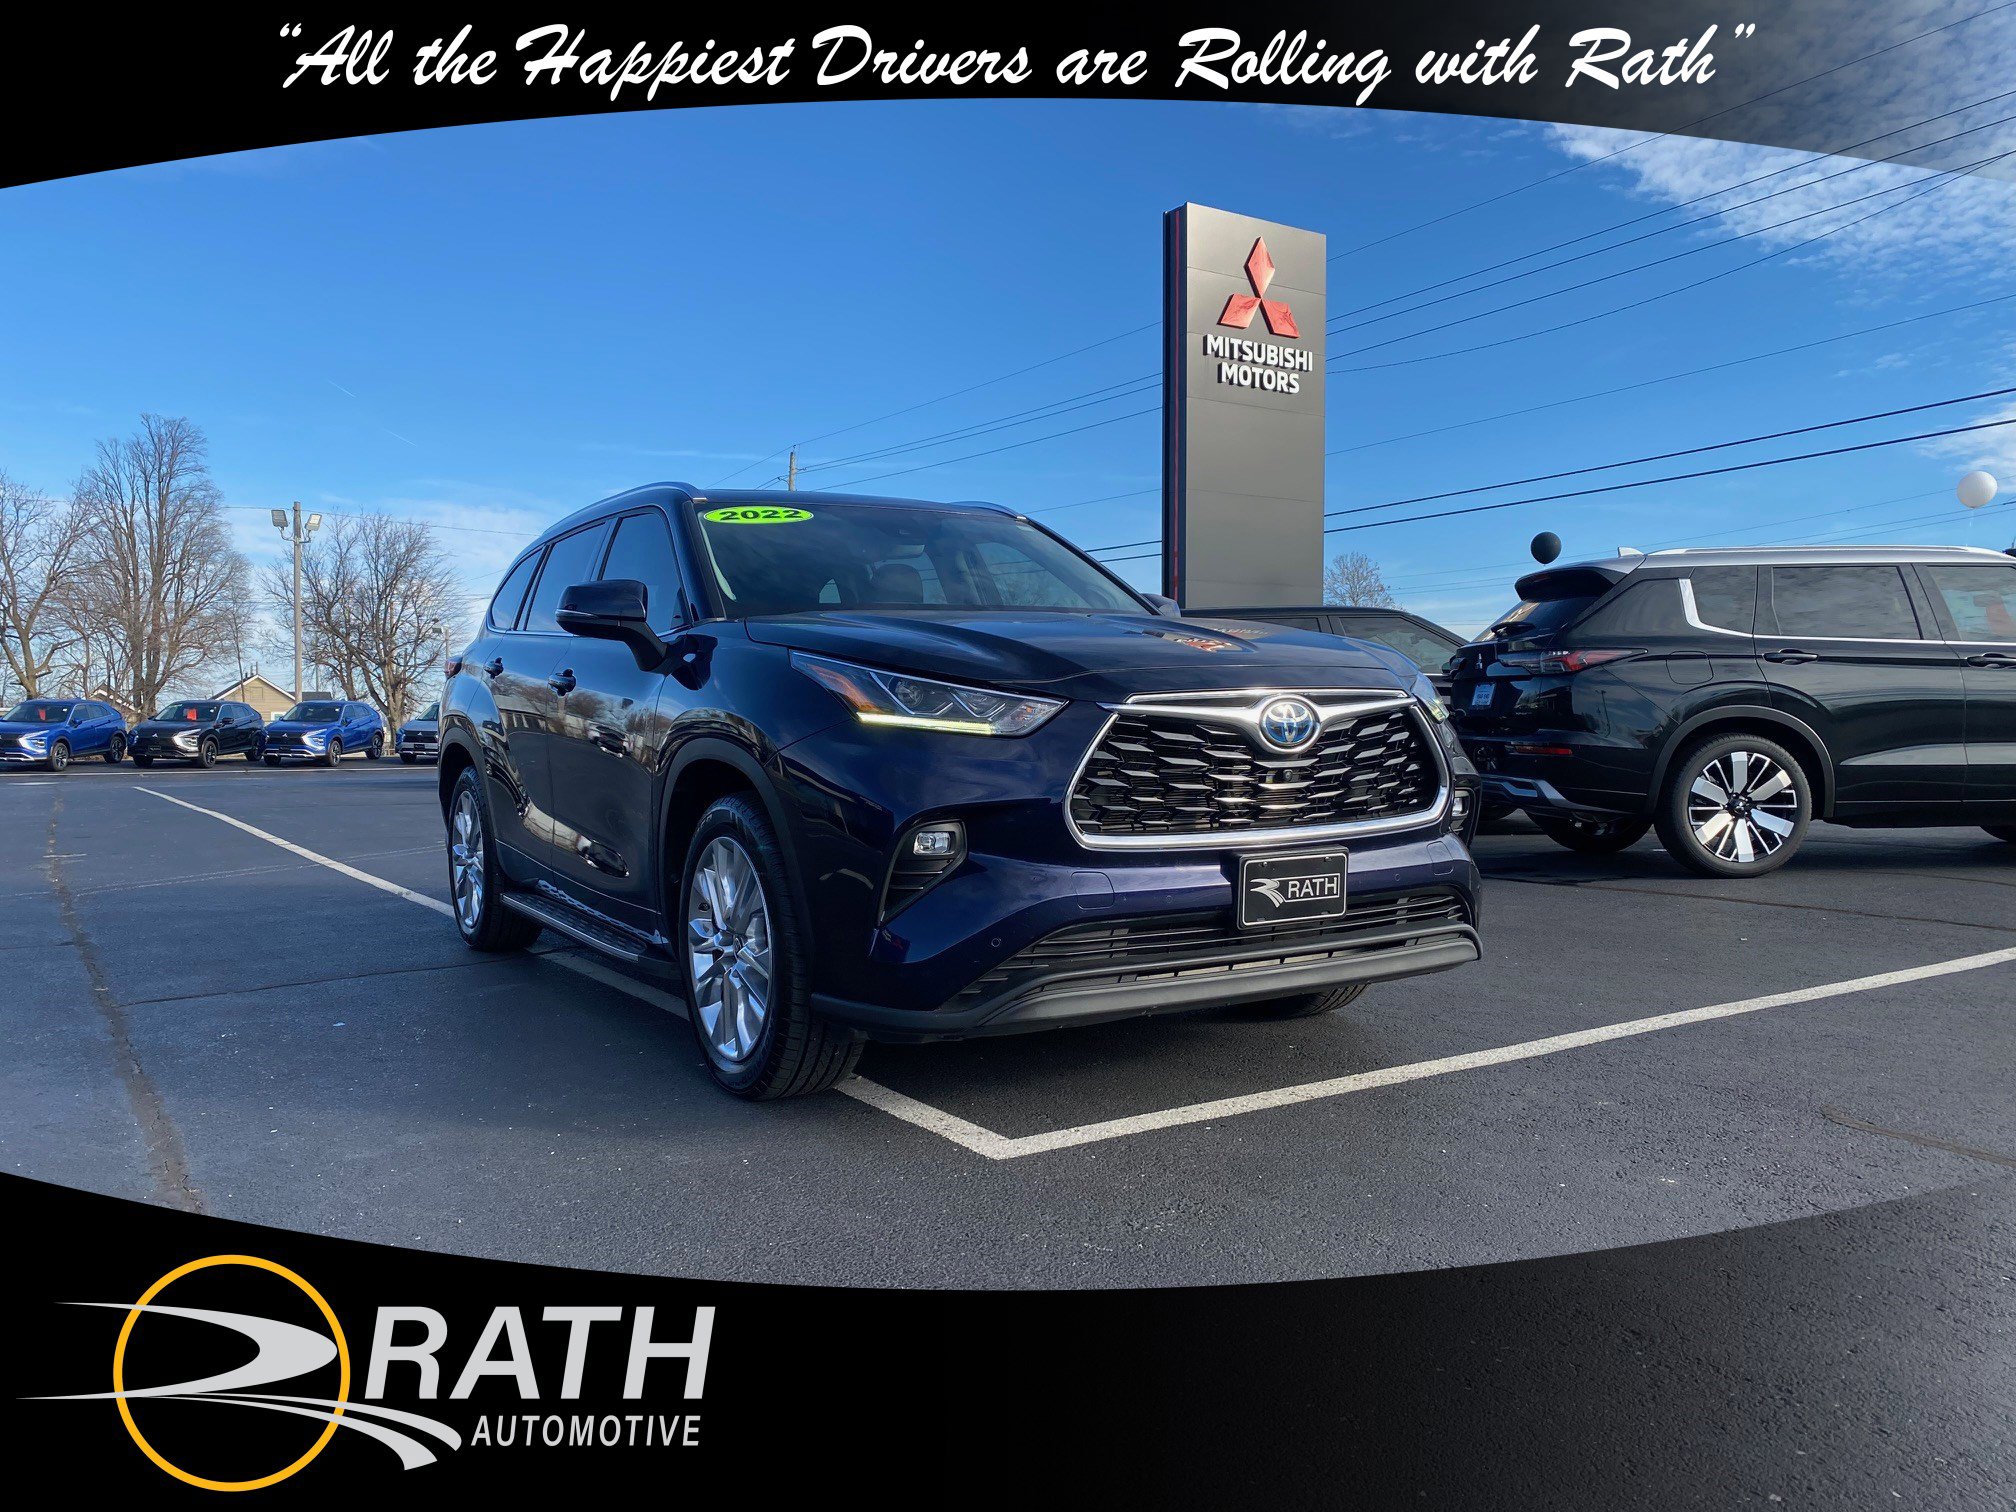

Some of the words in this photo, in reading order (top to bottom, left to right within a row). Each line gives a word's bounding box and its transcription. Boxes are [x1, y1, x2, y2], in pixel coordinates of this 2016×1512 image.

[1204, 333, 1314, 372] MITSUBISHI
[1219, 361, 1301, 394] MOTORS
[719, 509, 804, 521] 2022
[1287, 877, 1338, 899] RATH
